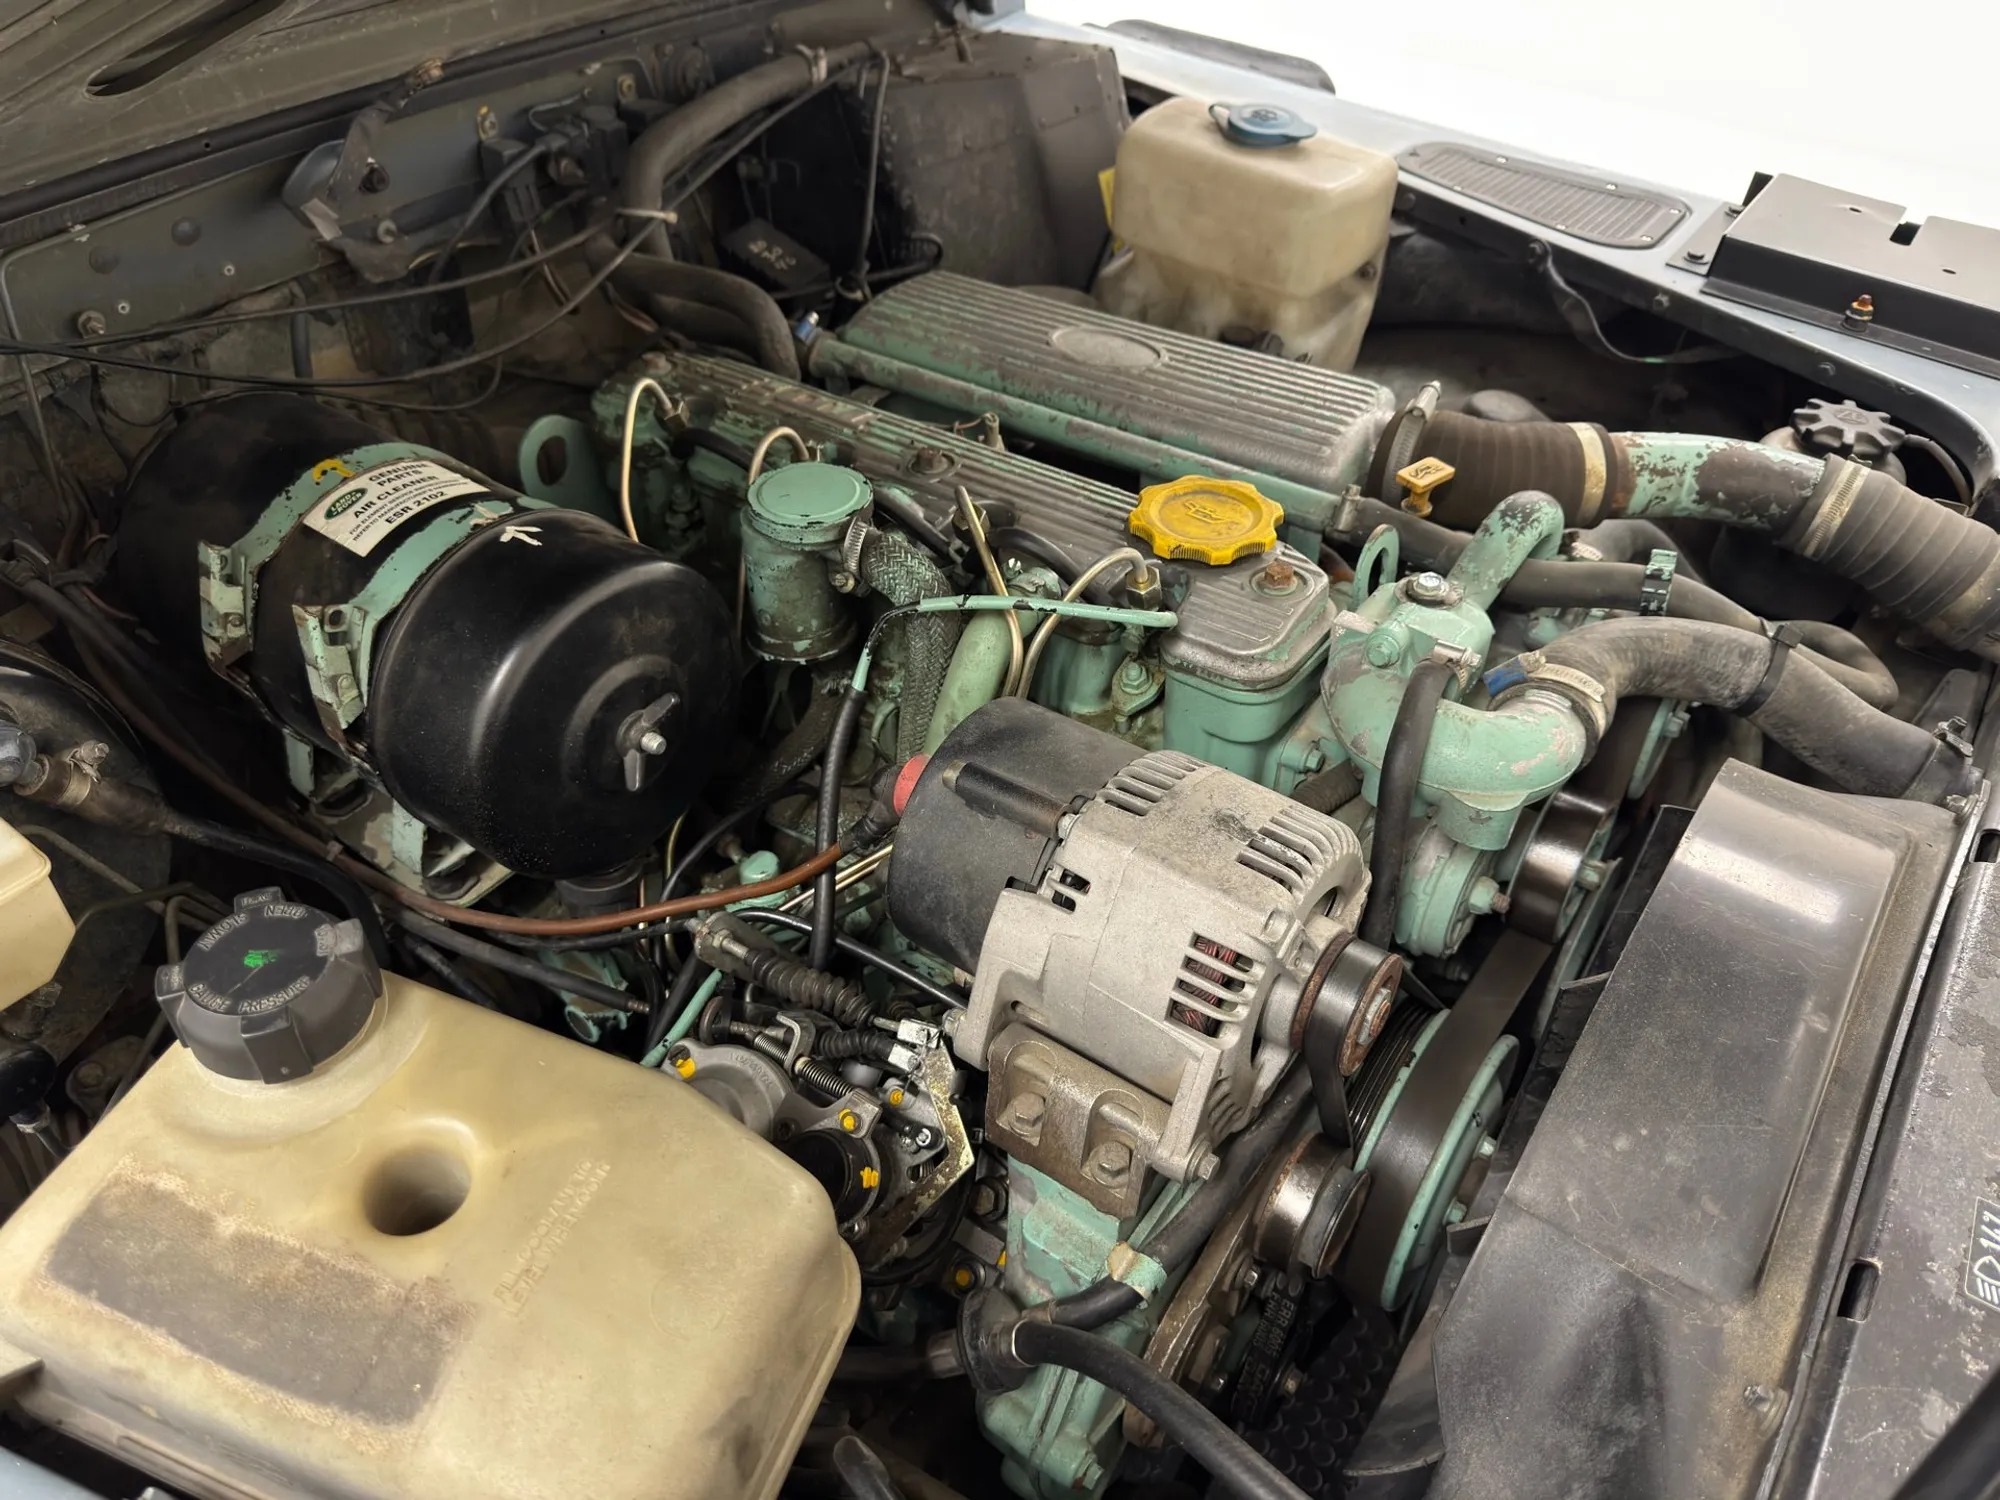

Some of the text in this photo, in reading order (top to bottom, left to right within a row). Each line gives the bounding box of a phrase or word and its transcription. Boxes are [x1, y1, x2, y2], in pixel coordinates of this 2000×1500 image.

[369, 463, 431, 482] GENUINE
[377, 469, 422, 486] PARTS
[353, 501, 376, 519] AIR
[376, 475, 439, 501] CLEANER
[385, 490, 448, 525] ESR 2102
[493, 1268, 524, 1302] FILL
[516, 1178, 575, 1263] COOLANT
[504, 1265, 549, 1317] LEVEL
